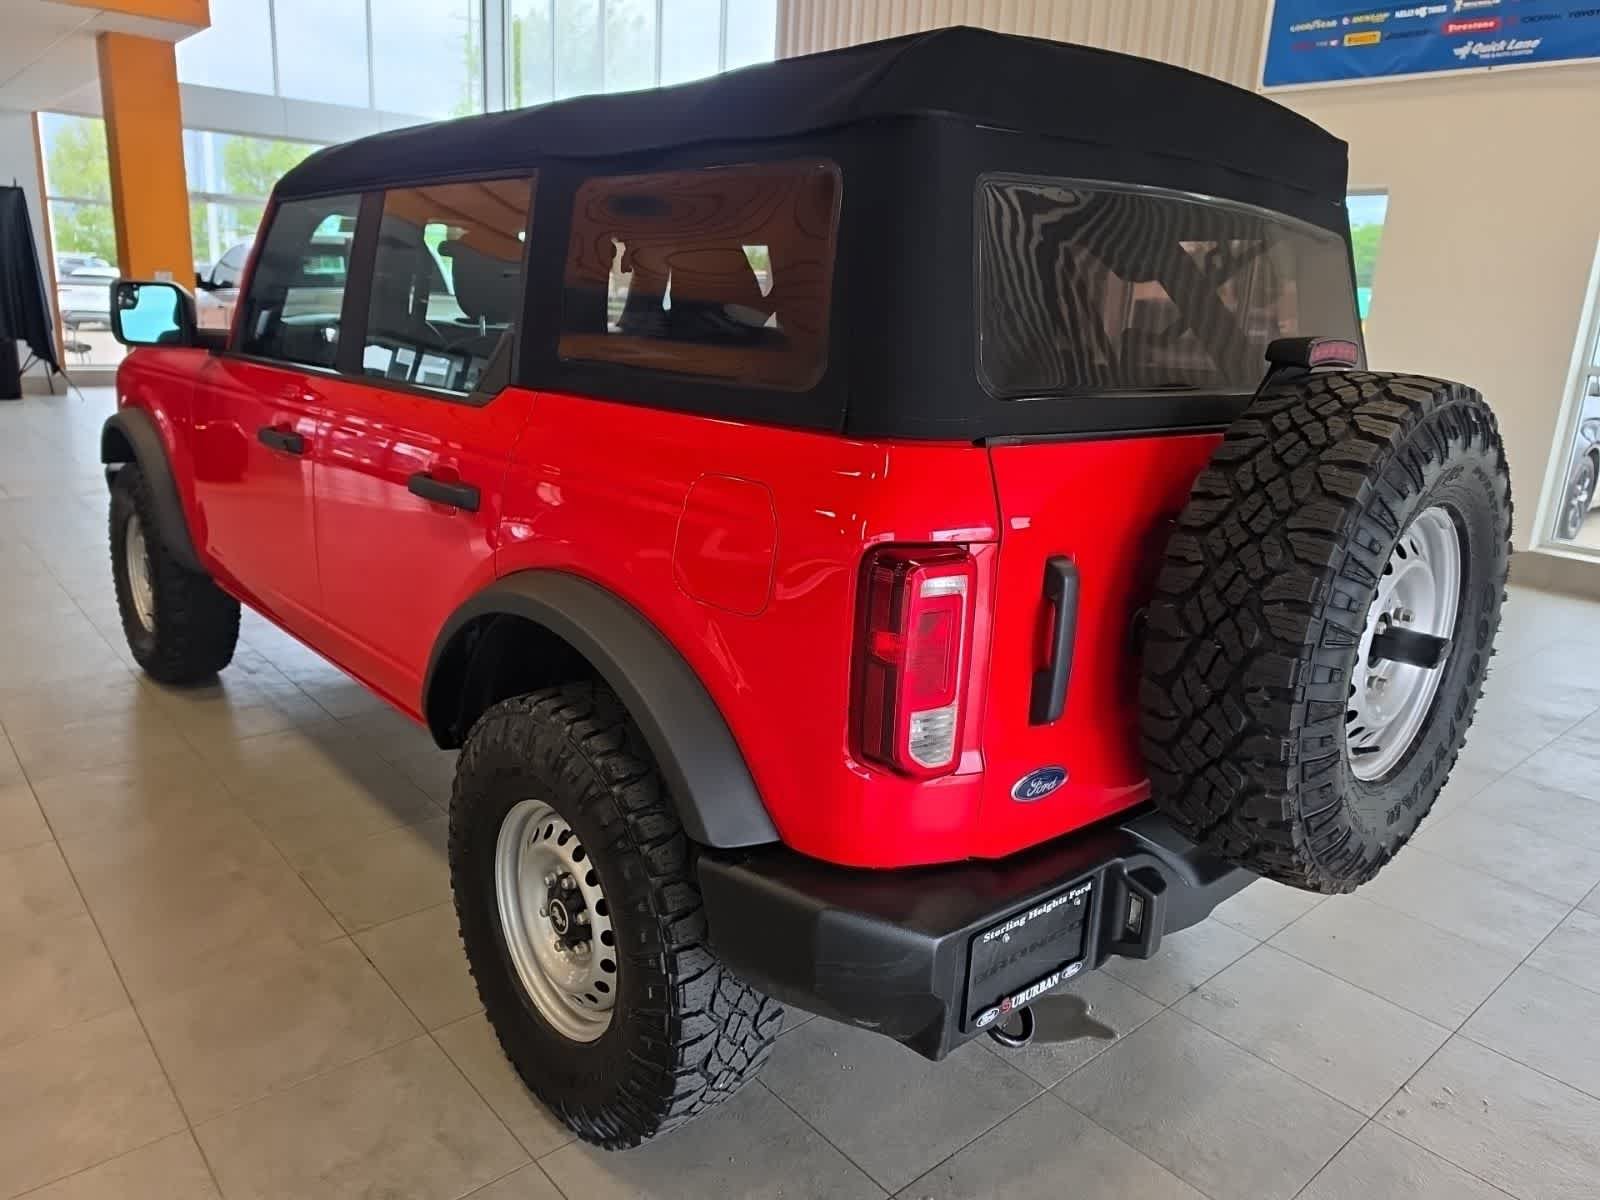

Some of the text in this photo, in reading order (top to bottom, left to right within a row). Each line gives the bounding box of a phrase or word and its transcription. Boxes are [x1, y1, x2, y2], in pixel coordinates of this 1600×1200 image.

[1471, 40, 1507, 55] Quick
[1506, 37, 1544, 51] Lane
[1026, 775, 1059, 798] Ford
[983, 881, 1092, 943] Sterling Heights Ford
[1000, 972, 1060, 1014] SUBURBAN
